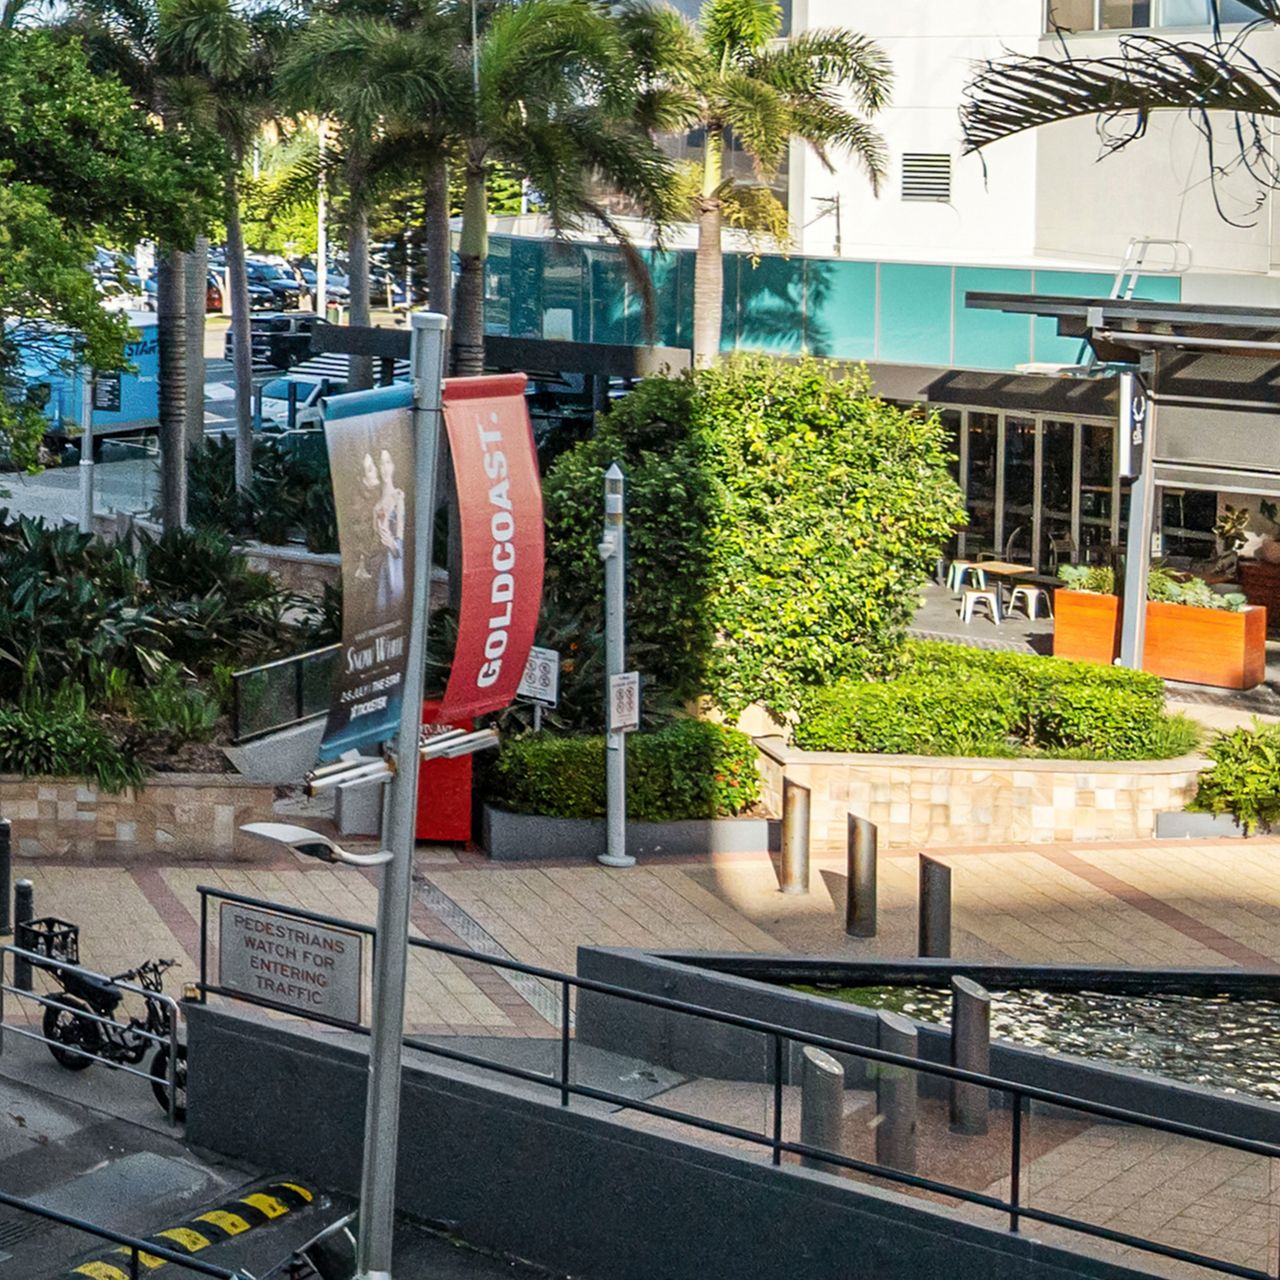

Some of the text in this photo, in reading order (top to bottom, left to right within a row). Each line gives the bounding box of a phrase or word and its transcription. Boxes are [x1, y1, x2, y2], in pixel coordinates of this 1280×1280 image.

[234, 914, 345, 954] PEDESTRIANS
[243, 935, 335, 970] WATCH FOR
[250, 955, 329, 987] ENTERING
[255, 974, 323, 1004] TRAFFIC
